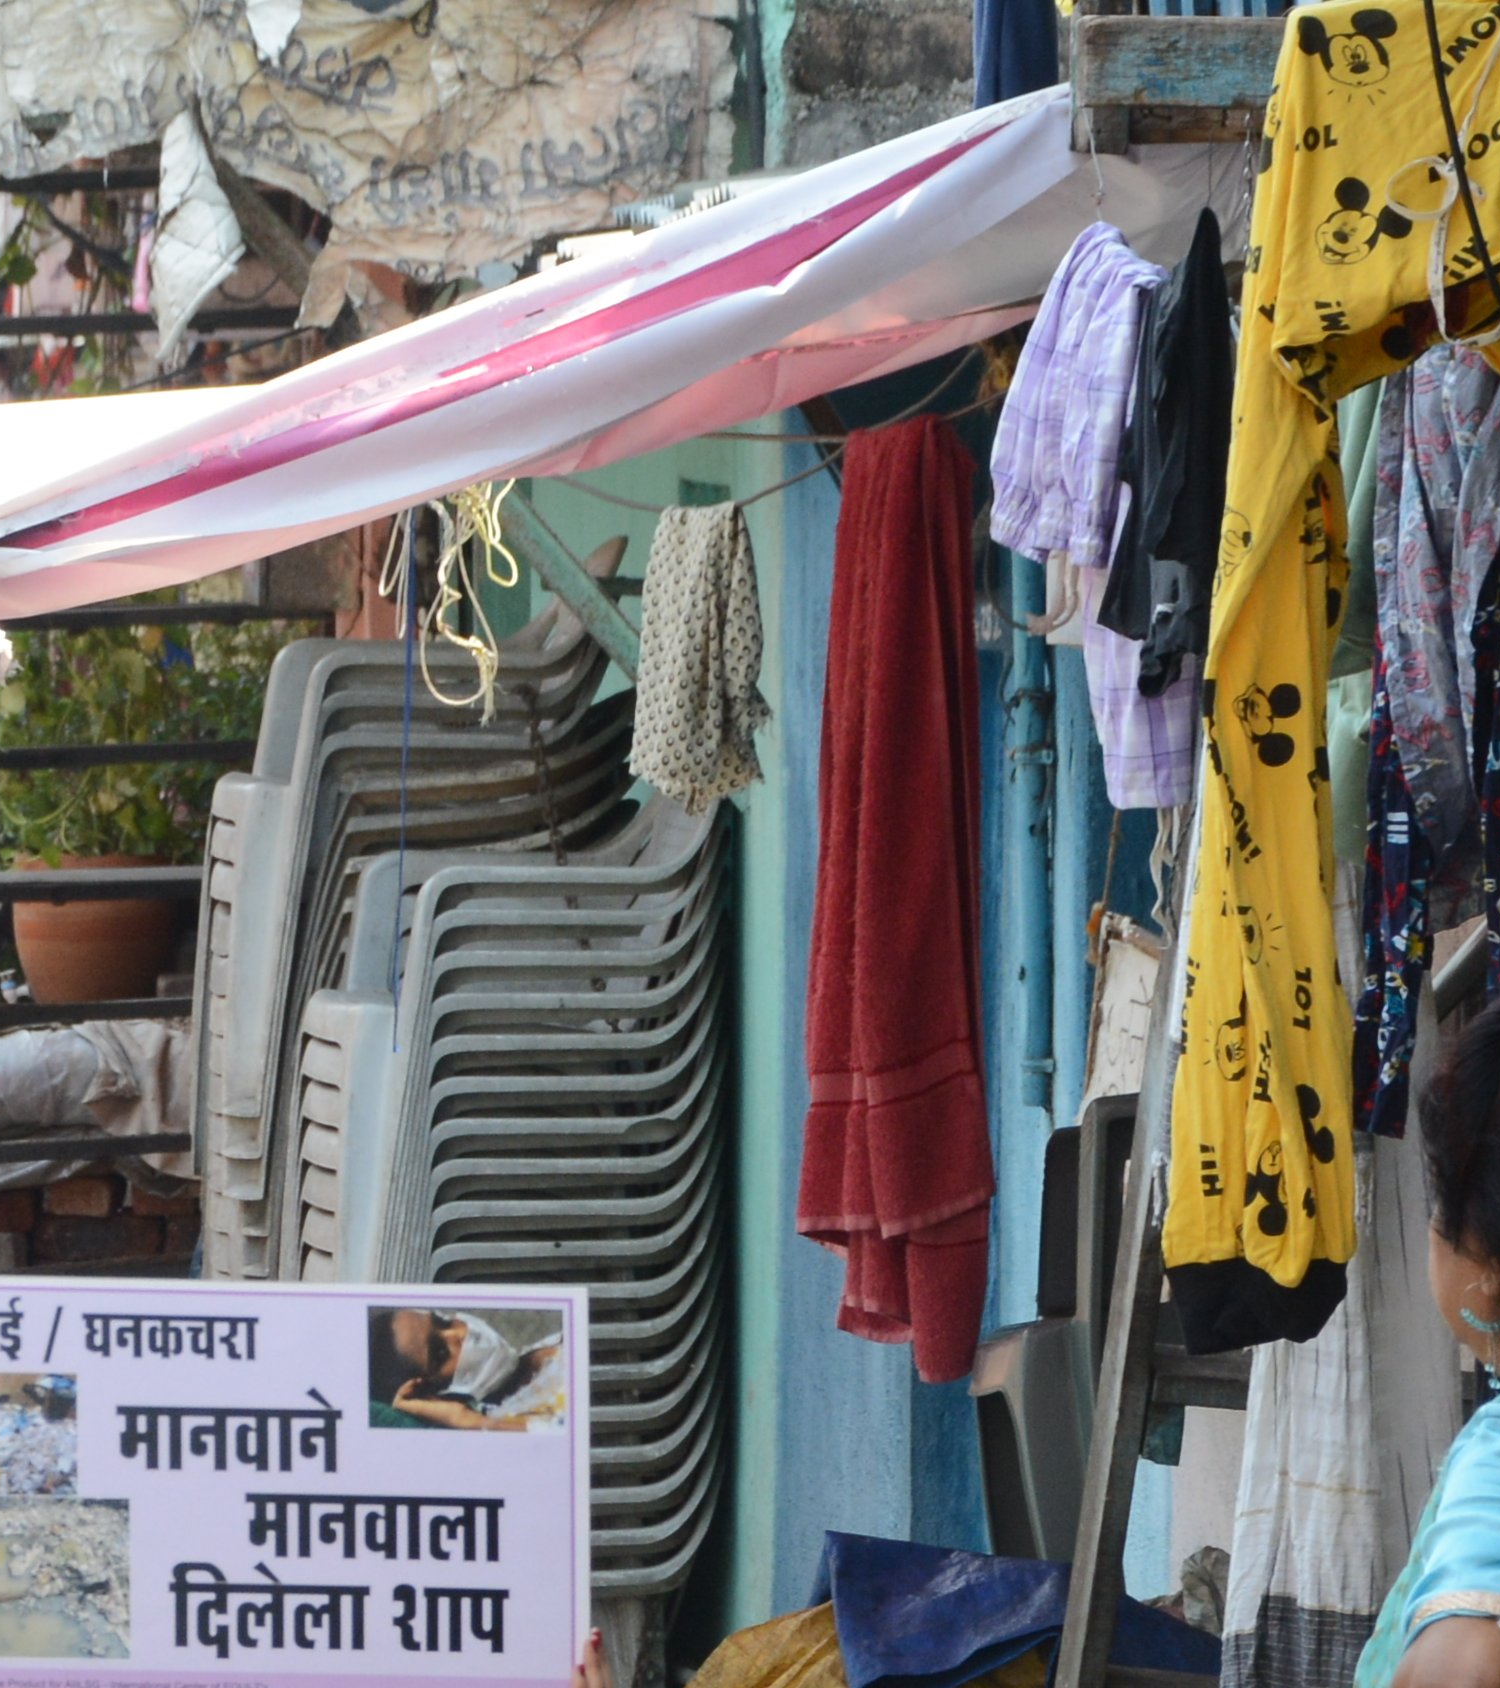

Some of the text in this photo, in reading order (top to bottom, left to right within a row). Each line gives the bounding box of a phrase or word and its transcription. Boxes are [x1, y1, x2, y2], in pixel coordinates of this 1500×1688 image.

[45, 1306, 63, 1363] /
[83, 1313, 259, 1362] घनकचरा
[116, 1388, 343, 1474] मानवाने
[245, 1493, 505, 1562] मानवाला
[168, 1562, 510, 1660] दिलेला शाप
